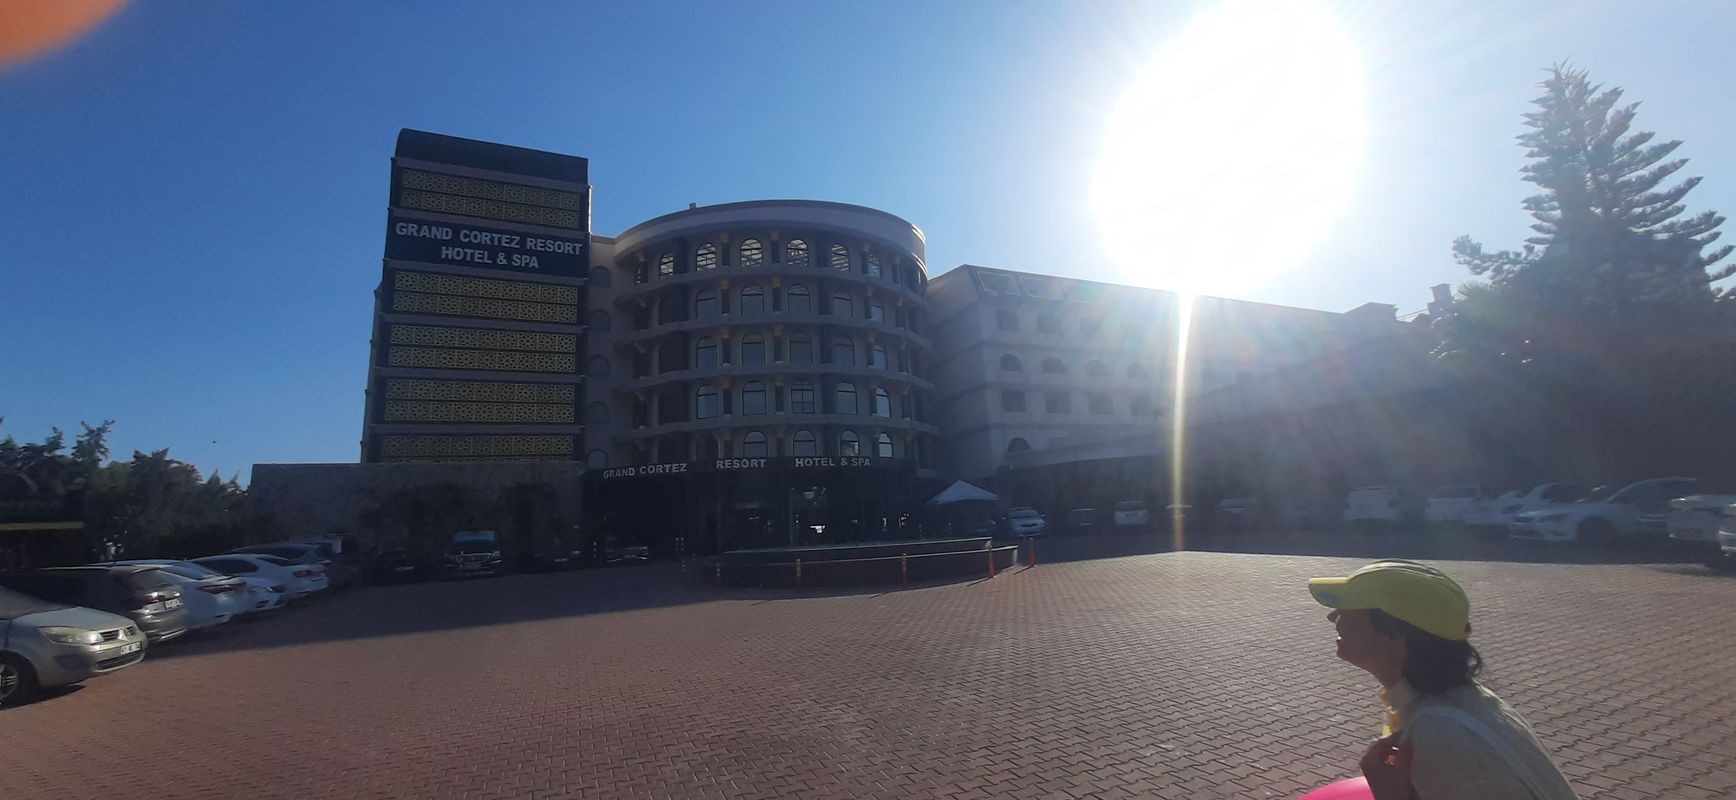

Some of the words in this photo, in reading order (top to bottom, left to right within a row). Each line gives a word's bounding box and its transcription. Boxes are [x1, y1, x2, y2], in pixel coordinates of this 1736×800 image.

[395, 222, 452, 240] GRAND
[459, 229, 521, 249] CORTEZ
[526, 237, 582, 256] RESORT
[441, 246, 492, 264] HOTEL
[497, 252, 508, 265] &
[511, 253, 540, 269] SPA
[603, 467, 636, 479] GRAND
[639, 462, 688, 475] CORTEZ
[716, 458, 767, 470] RESORT
[795, 457, 836, 468] HOTEL
[840, 457, 849, 467] &
[851, 457, 871, 467] SPA
